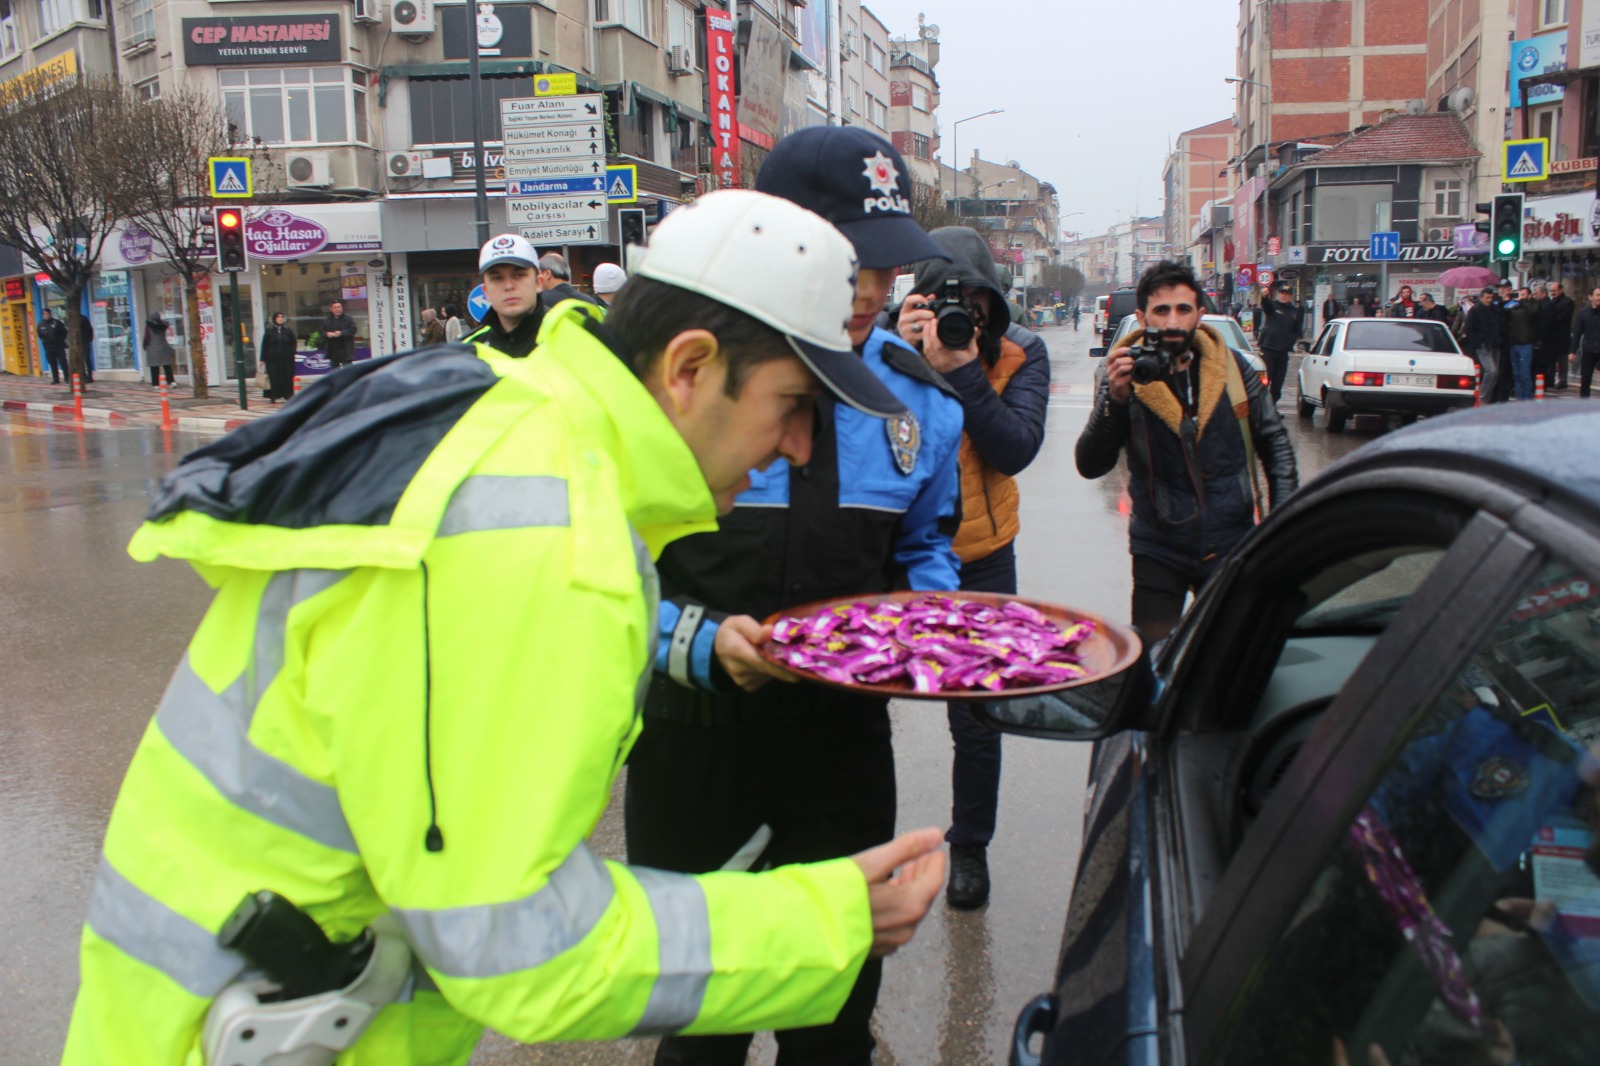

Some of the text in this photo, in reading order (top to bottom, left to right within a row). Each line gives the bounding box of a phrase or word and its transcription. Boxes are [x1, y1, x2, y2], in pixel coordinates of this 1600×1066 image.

[709, 15, 733, 30] ŞEHİR
[191, 19, 331, 44] CEP HASTANESİ
[218, 44, 308, 56] YETKİLİ TEKNİK SERVİS
[511, 100, 565, 111] Fuar Alanı
[507, 129, 578, 140] Hükümet Konağı
[508, 145, 571, 157] Kaymakamlık
[509, 166, 541, 176] Emniyet
[542, 164, 584, 174] Müdürlüğü
[521, 182, 569, 192] Jandarma
[512, 200, 584, 212] Mobilyacılar
[526, 212, 566, 221] Çarşısı
[274, 226, 322, 241] Hasan
[523, 228, 586, 239] Adalet Sarayı
[254, 239, 306, 254] Oğulları
[1260, 274, 1270, 283] 30
